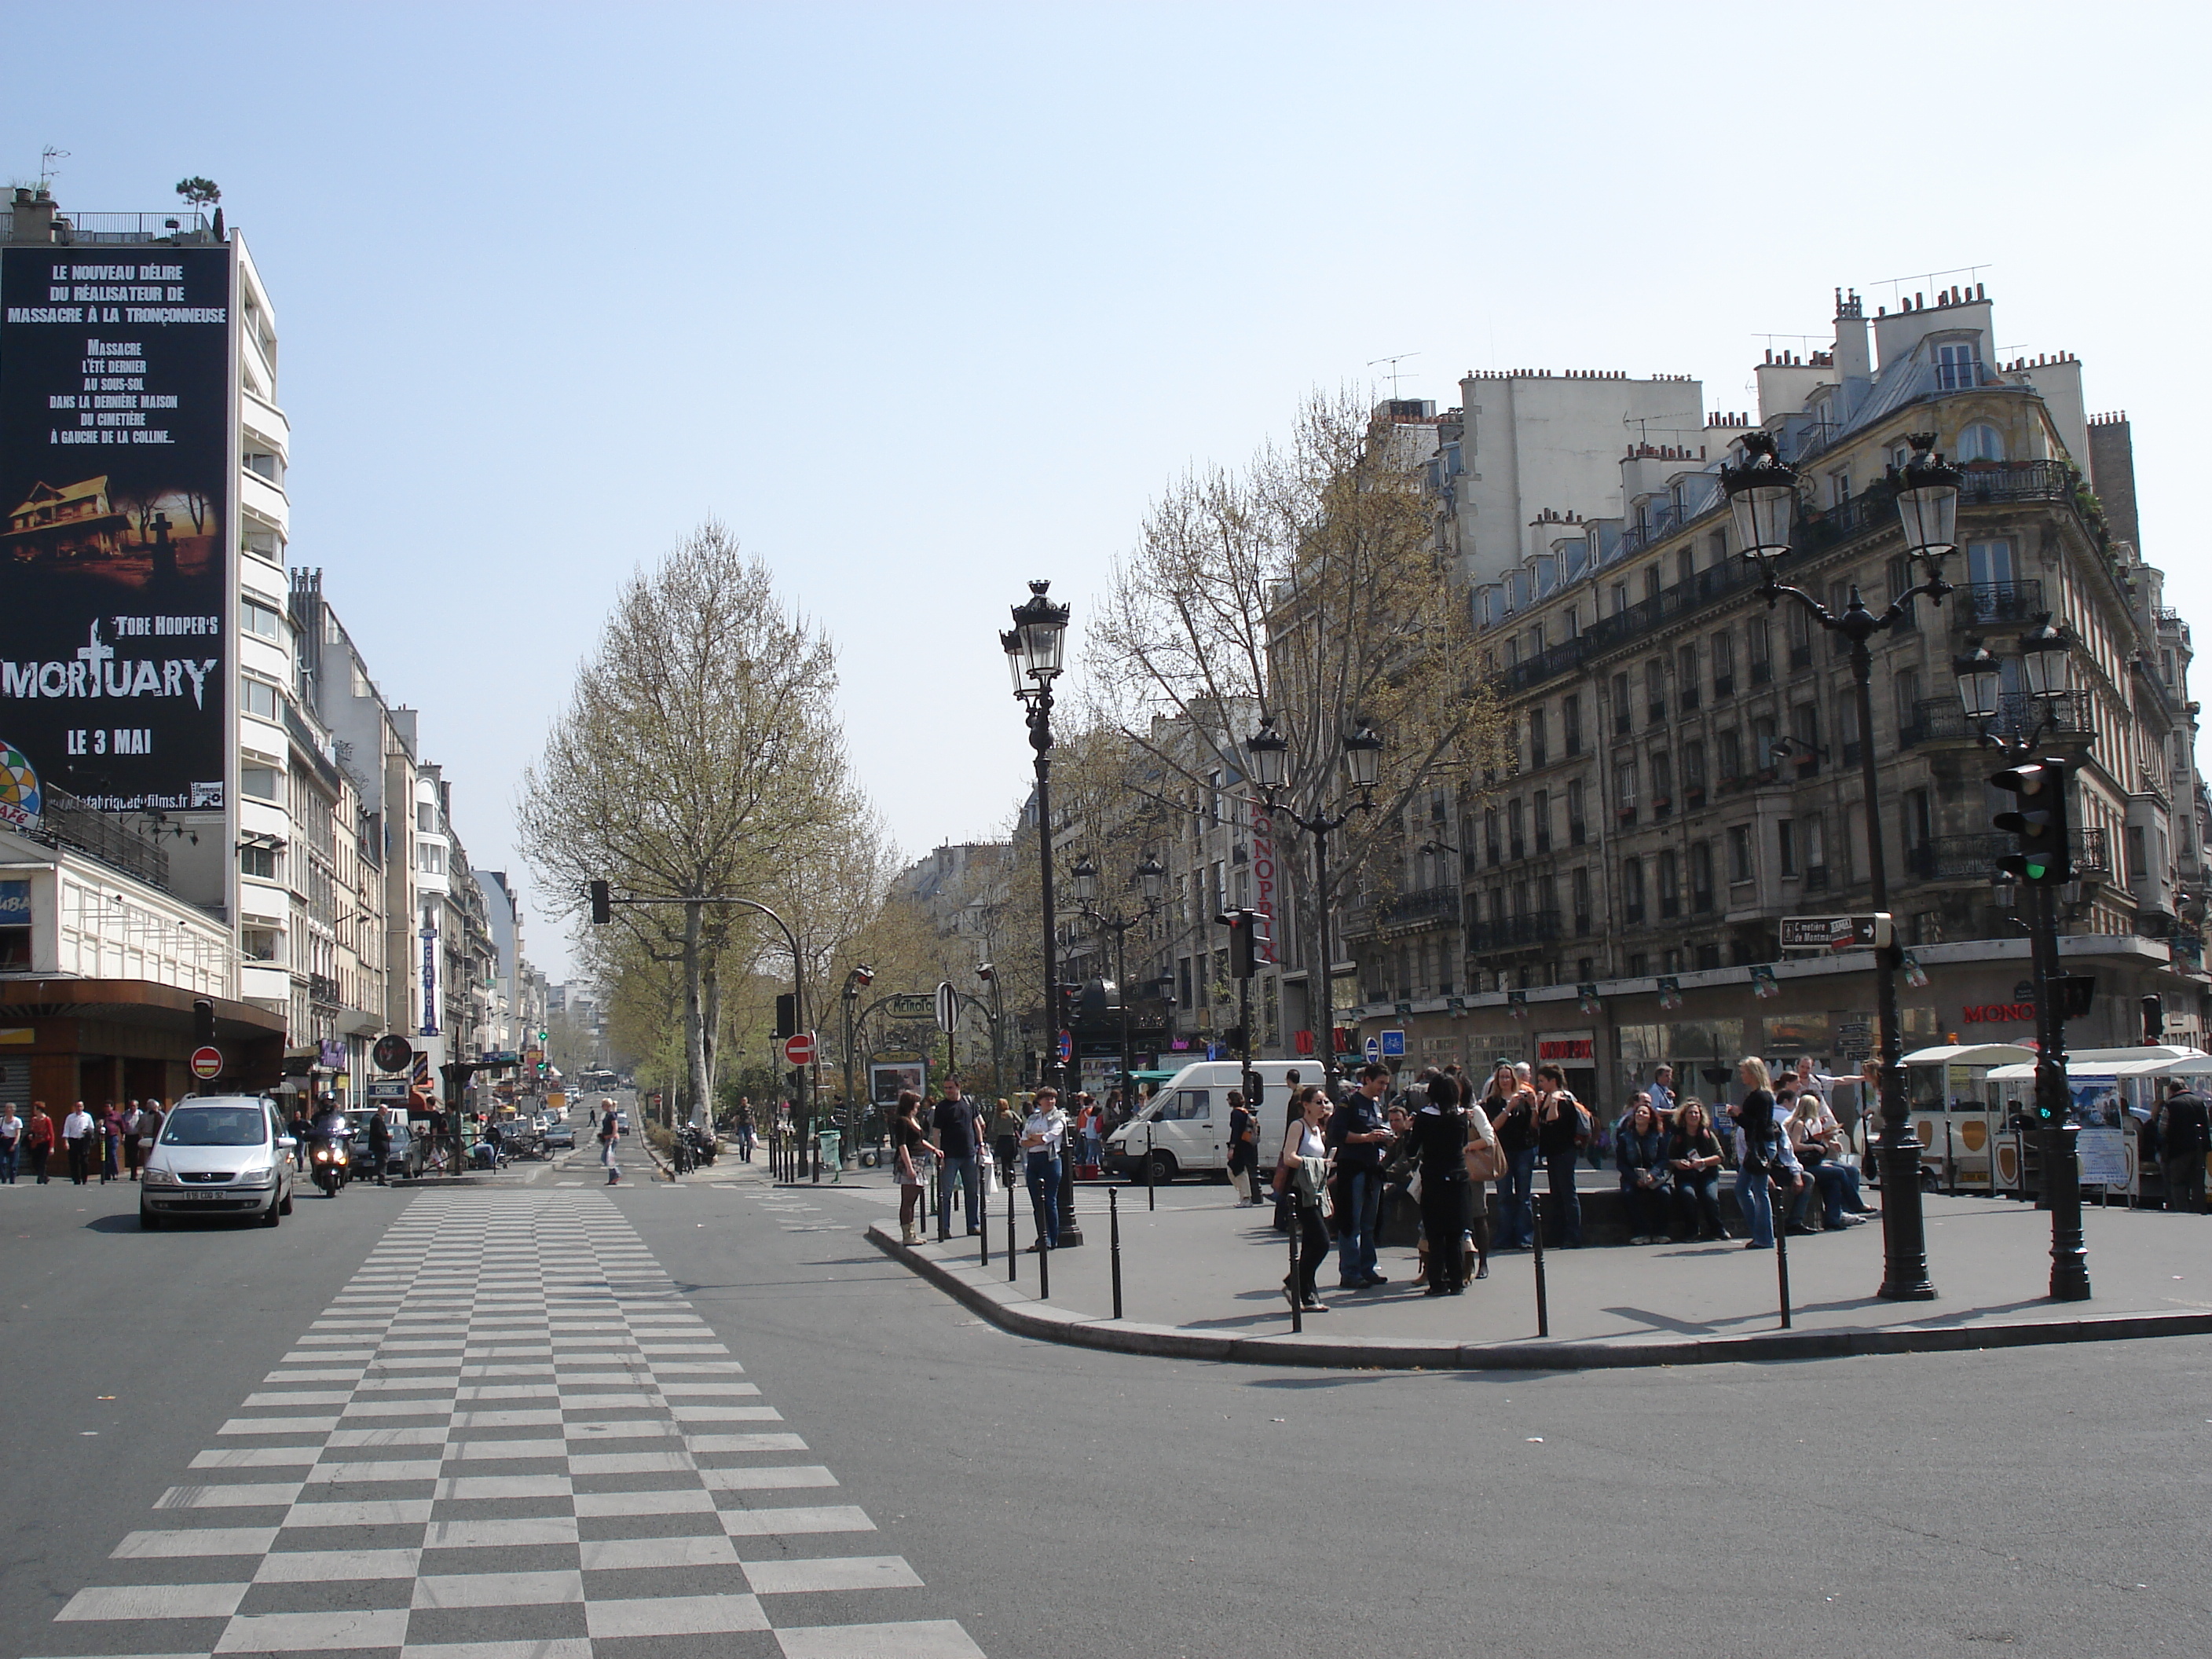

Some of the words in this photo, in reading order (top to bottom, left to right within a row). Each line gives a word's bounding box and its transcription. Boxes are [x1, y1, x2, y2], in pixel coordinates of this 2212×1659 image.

[53, 266, 67, 280] LE
[72, 266, 134, 280] NOUVEAU
[140, 262, 183, 280] DÉLIRE
[49, 287, 69, 301] DU
[74, 284, 162, 301] RÉALISATEUR
[167, 287, 184, 301] DE
[8, 308, 82, 323] MASSACRE
[87, 305, 97, 323] À
[103, 308, 119, 323] LA
[126, 308, 225, 326] TRONÇONNEUSE
[82, 358, 104, 373] L'ÉTÉ
[108, 360, 146, 373] DERNIER
[84, 378, 97, 390] AU
[101, 378, 144, 390] SOUS-SOL
[49, 396, 75, 408] DANS
[79, 395, 90, 408] LA
[94, 393, 137, 408] DERNIÈRE
[141, 395, 178, 408] MAISON
[81, 413, 93, 426] DU
[97, 411, 145, 426] CIMETIÈRE
[50, 430, 57, 444] À
[61, 430, 98, 444] GAUCHE
[101, 430, 114, 444] DE
[117, 430, 128, 444] LA
[156, 616, 218, 635] HOOPER'S
[0, 617, 218, 711] MORTUARY
[68, 730, 86, 755] LE
[94, 730, 106, 755] 3
[114, 729, 151, 755] MAI
[1963, 1003, 2035, 1023] MONO
[375, 1086, 398, 1094] CHANGE
